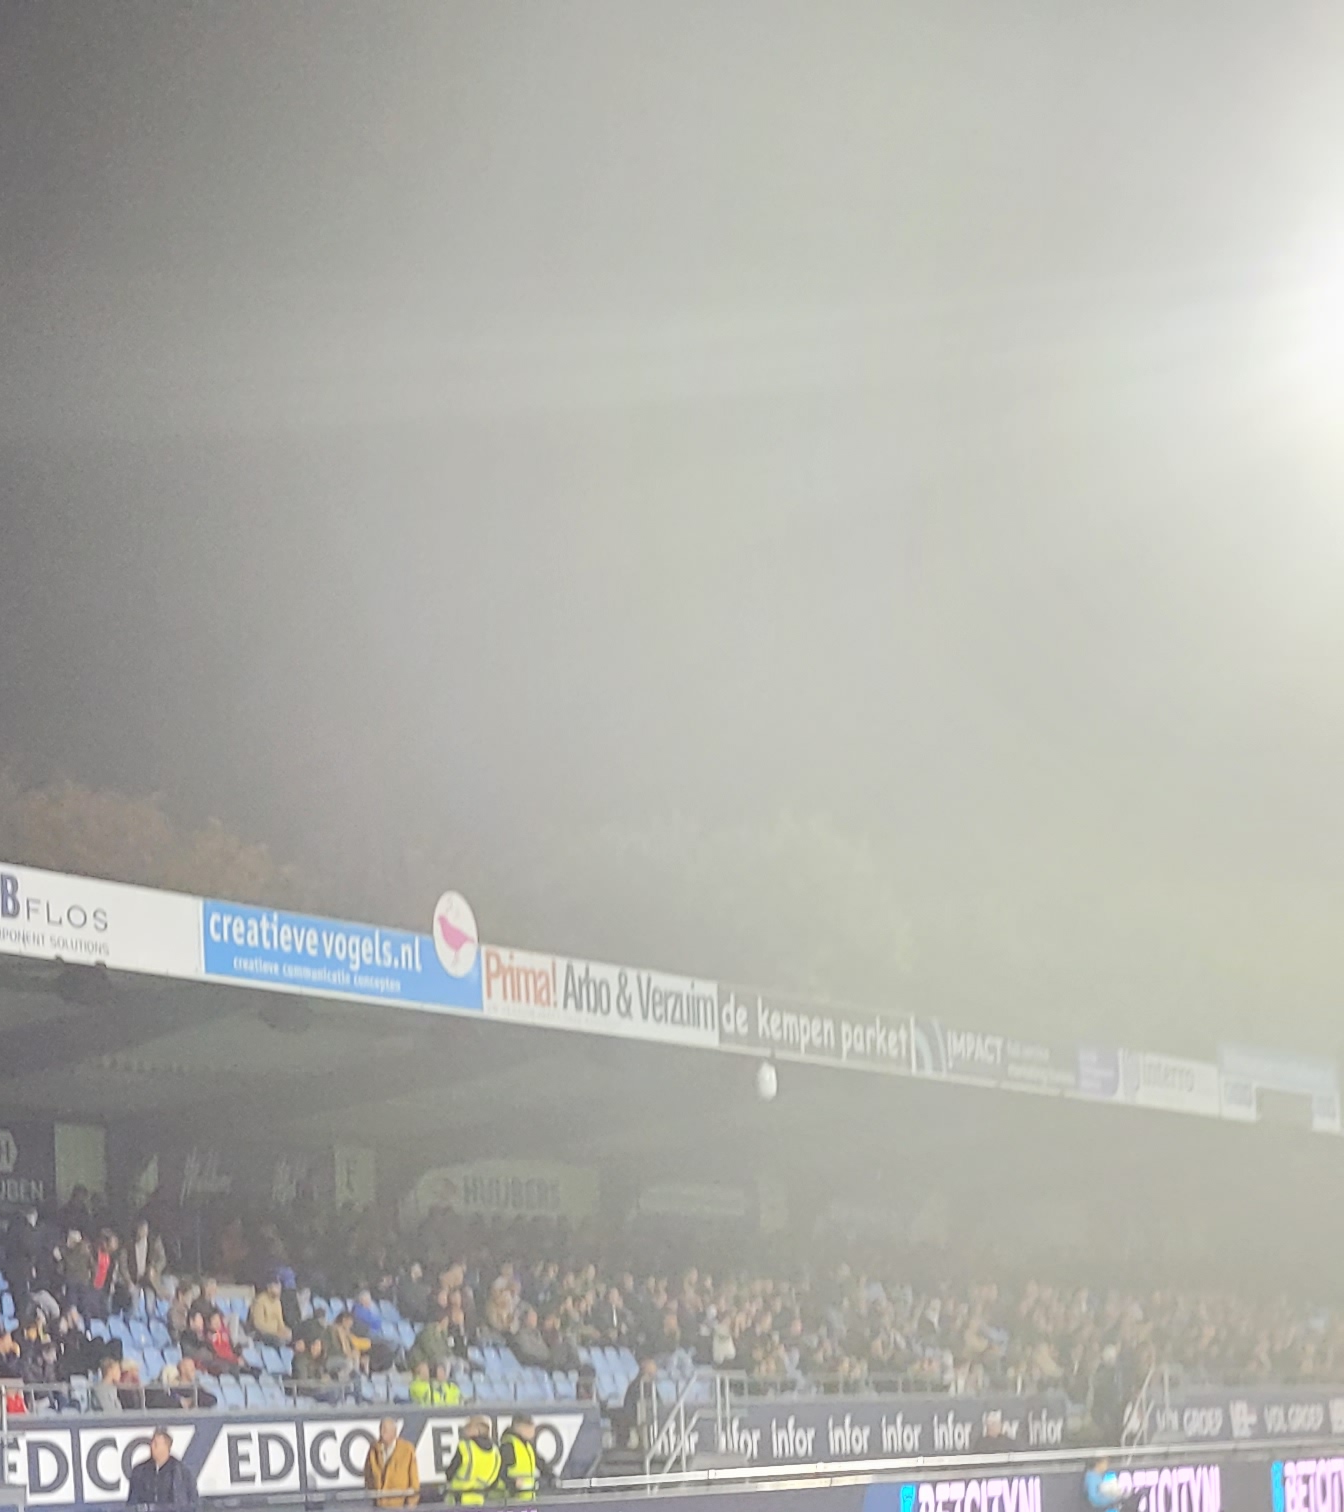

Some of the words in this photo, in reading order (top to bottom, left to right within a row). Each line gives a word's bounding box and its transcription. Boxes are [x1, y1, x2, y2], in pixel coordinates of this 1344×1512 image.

[25, 898, 109, 933] FLOS
[50, 935, 110, 956] SOLUTIONS
[484, 948, 558, 1009] Prima!
[563, 960, 611, 1015] Arbo
[616, 967, 633, 1020] &
[636, 972, 715, 1032] Verzuim
[722, 992, 748, 1034] de
[757, 995, 835, 1056] kempen
[227, 1428, 377, 1484] EDCO
